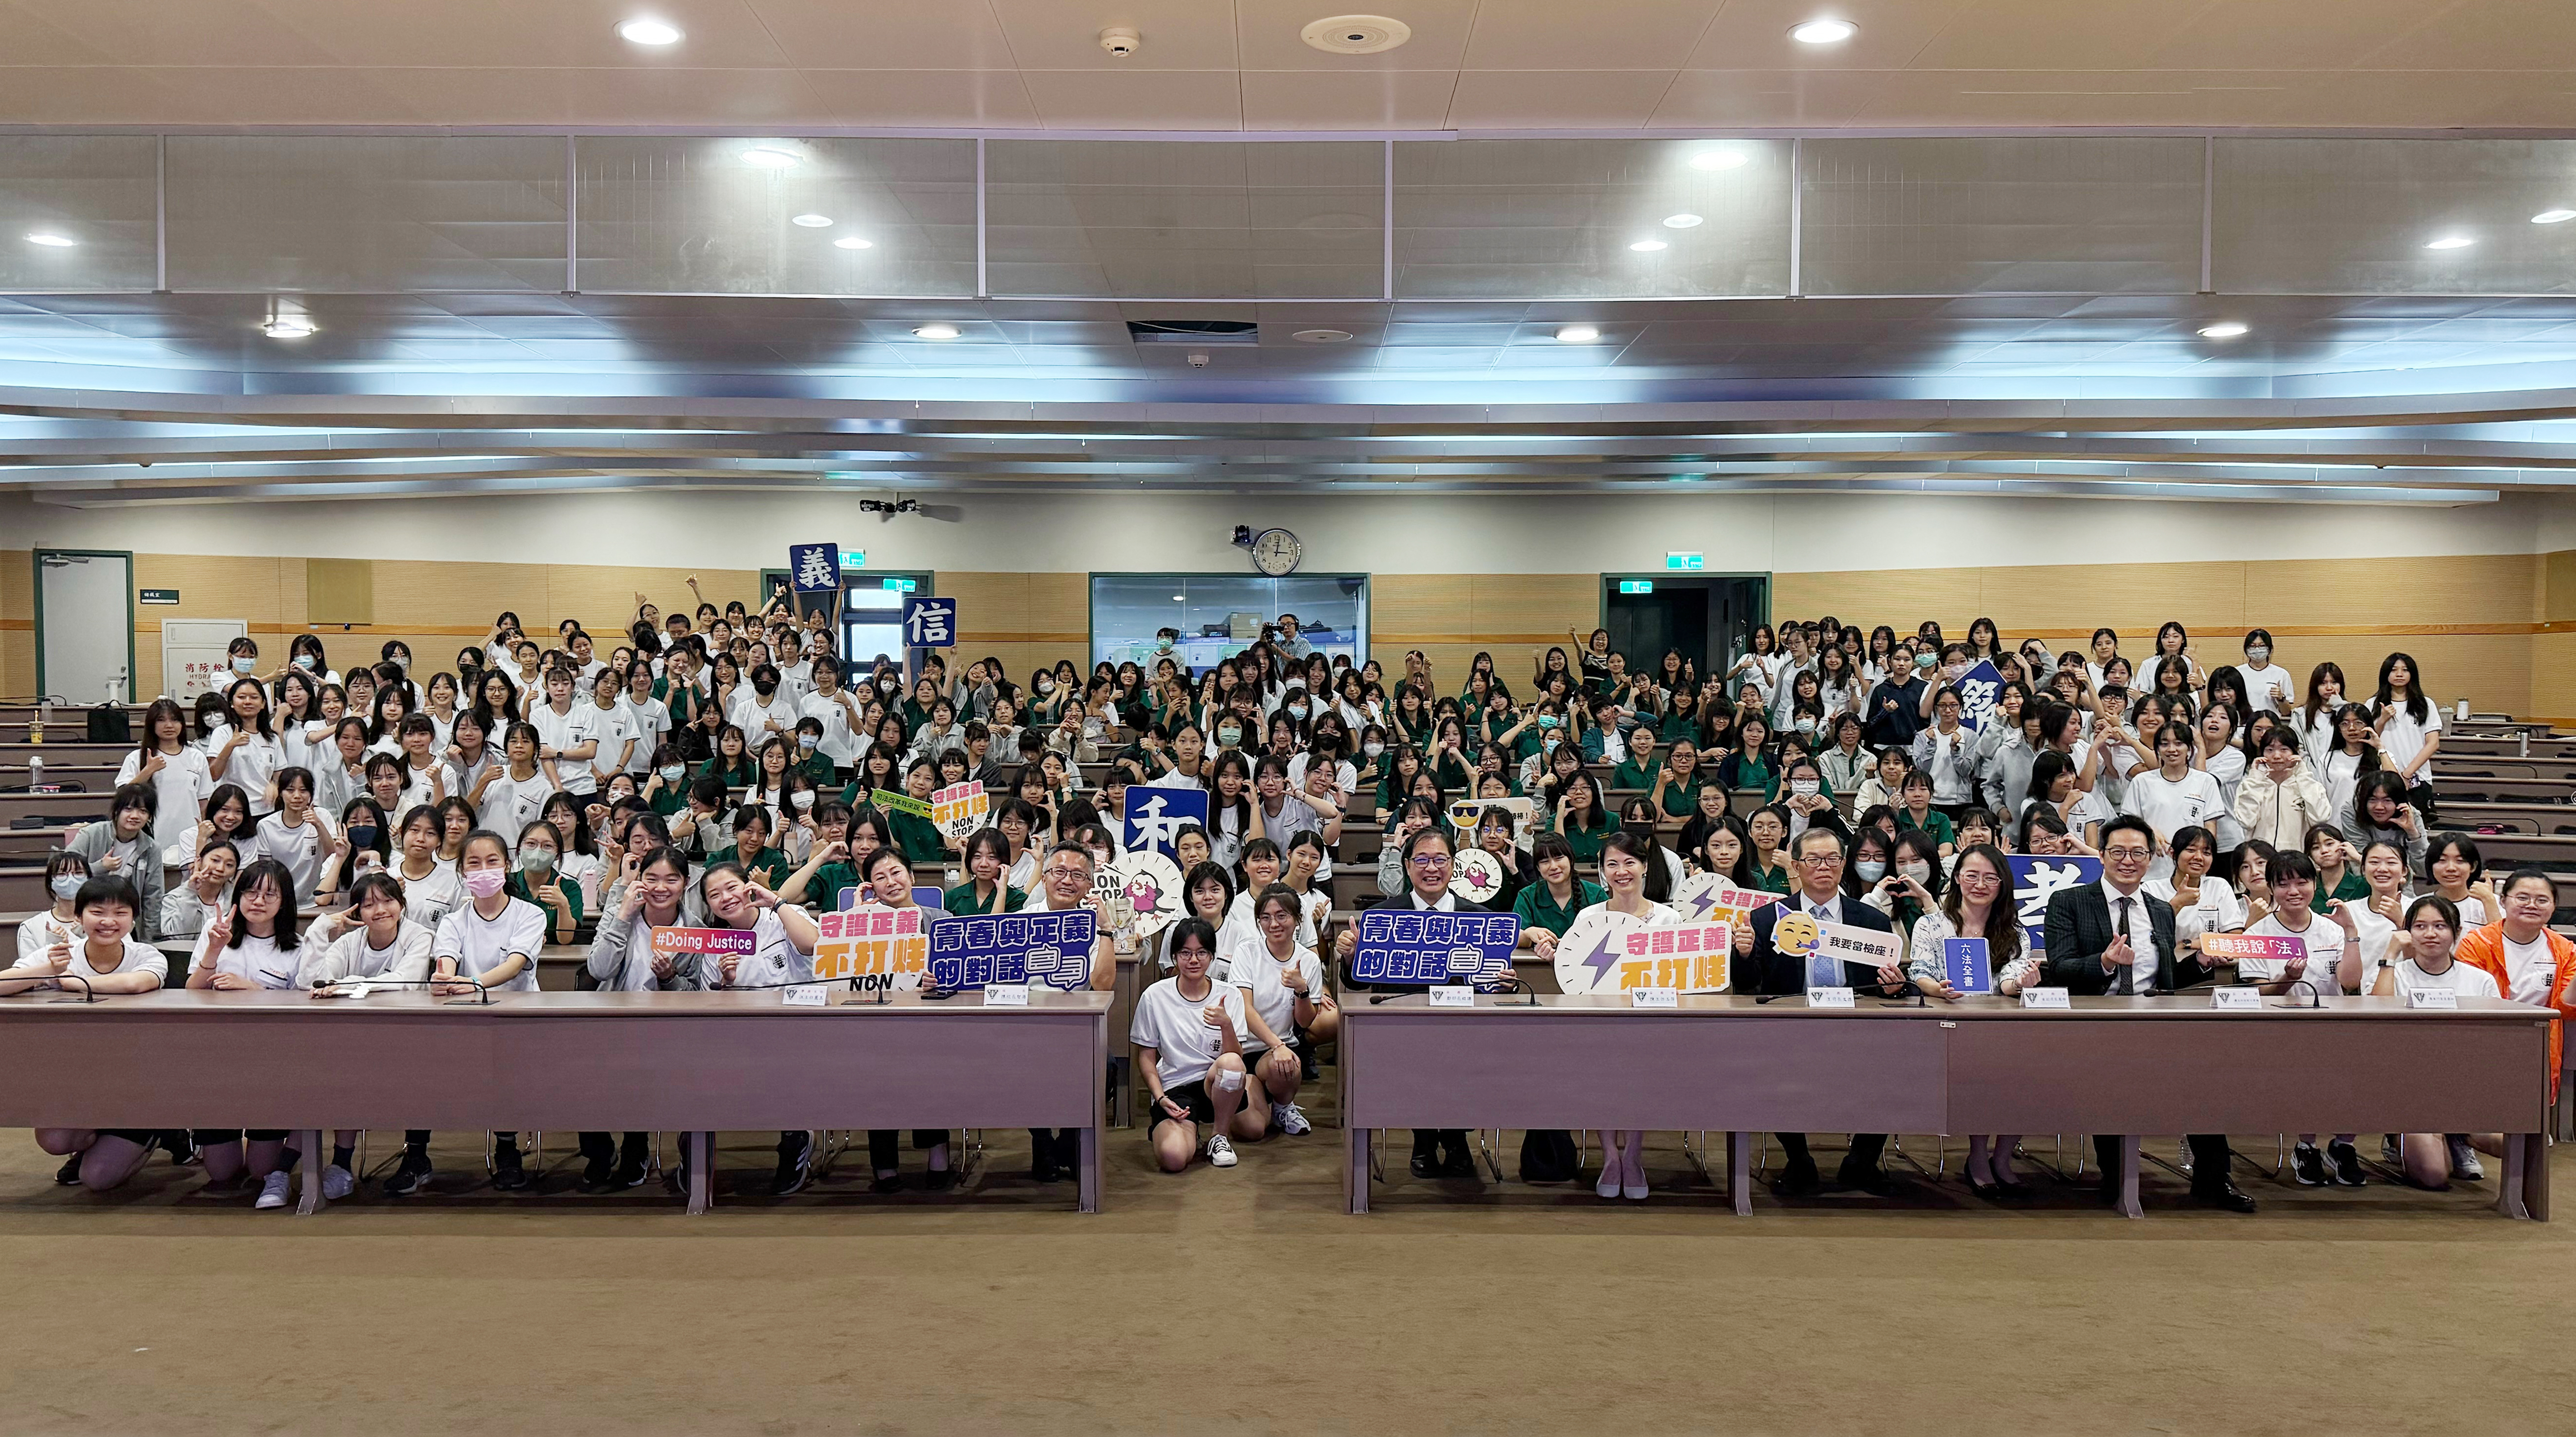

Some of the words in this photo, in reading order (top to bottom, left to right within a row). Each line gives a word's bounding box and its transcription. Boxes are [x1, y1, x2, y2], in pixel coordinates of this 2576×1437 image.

[798, 547, 836, 588] 義
[906, 602, 952, 643] 信
[185, 663, 224, 672] 消防栓
[934, 782, 982, 803] 守護正義
[934, 794, 988, 824] 不打烊
[952, 816, 974, 829] NON
[952, 825, 974, 838] STOP
[1129, 795, 1201, 852] 和
[1097, 875, 1120, 888] ON
[1721, 890, 1784, 909] 守護正
[821, 910, 918, 938] 守護正義
[934, 914, 1091, 951] 青春與正義
[1363, 914, 1516, 946] 青春與正義
[655, 932, 703, 950] #Doing
[707, 933, 752, 950] Justice
[1627, 927, 1726, 955] 守護正義
[1829, 937, 1894, 957] 我要當檢座！
[2208, 938, 2302, 956] #聽我說「法」
[815, 937, 926, 978] 不打烊
[933, 952, 1025, 987] 的對話
[1356, 949, 1447, 979] 的對話
[1960, 943, 1973, 987] 六法全書
[849, 973, 894, 991] NON
[1620, 954, 1726, 990] 不打烊
